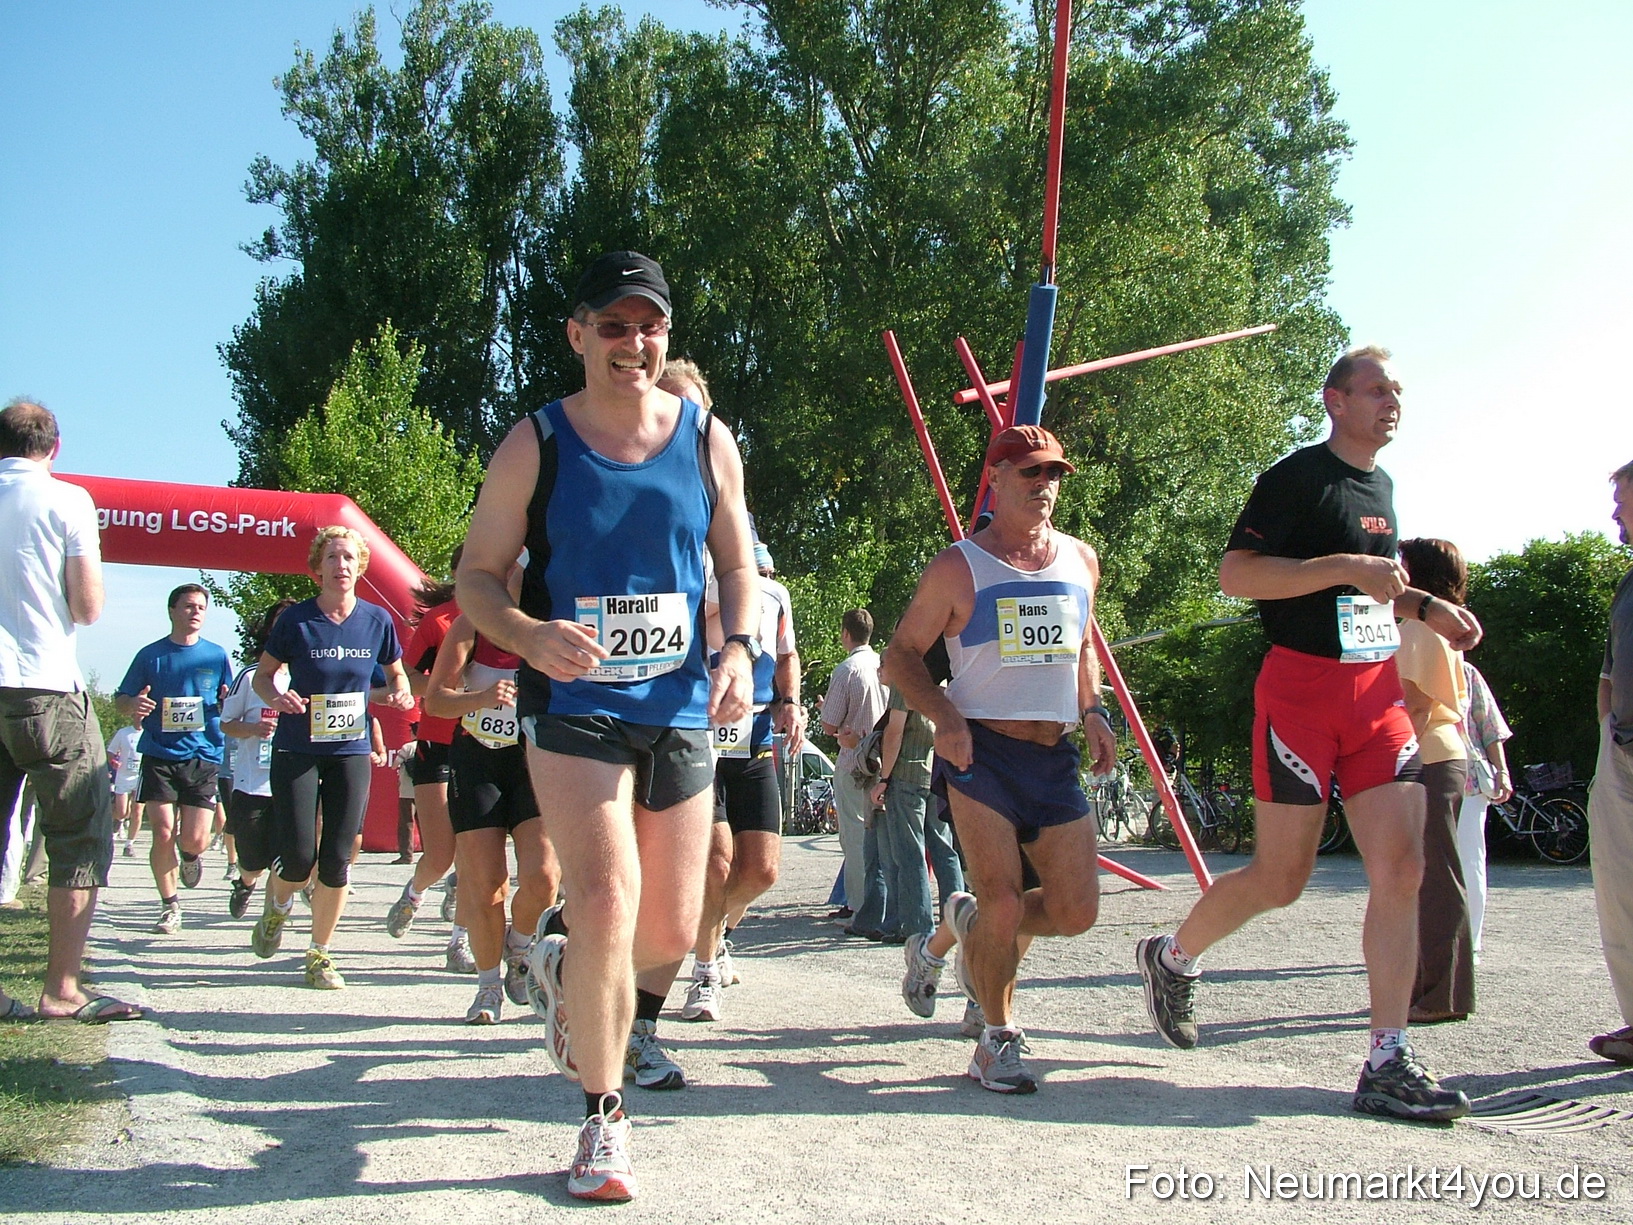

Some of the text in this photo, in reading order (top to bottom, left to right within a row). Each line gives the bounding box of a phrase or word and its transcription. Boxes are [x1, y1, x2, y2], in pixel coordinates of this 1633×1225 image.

[171, 508, 297, 538] LGS-Park
[606, 596, 658, 615] Harald
[1019, 604, 1048, 617] Hans
[1004, 623, 1013, 634] D
[1342, 621, 1349, 633] B
[1022, 625, 1063, 646] 902
[1355, 624, 1392, 644] 3047
[610, 625, 684, 657] 2024
[310, 648, 372, 659] EURO POLES
[326, 699, 356, 708] Ramona
[172, 712, 194, 723] 874
[314, 712, 321, 720] C
[327, 714, 355, 729] 230
[481, 717, 516, 736] 683
[261, 744, 268, 752] C
